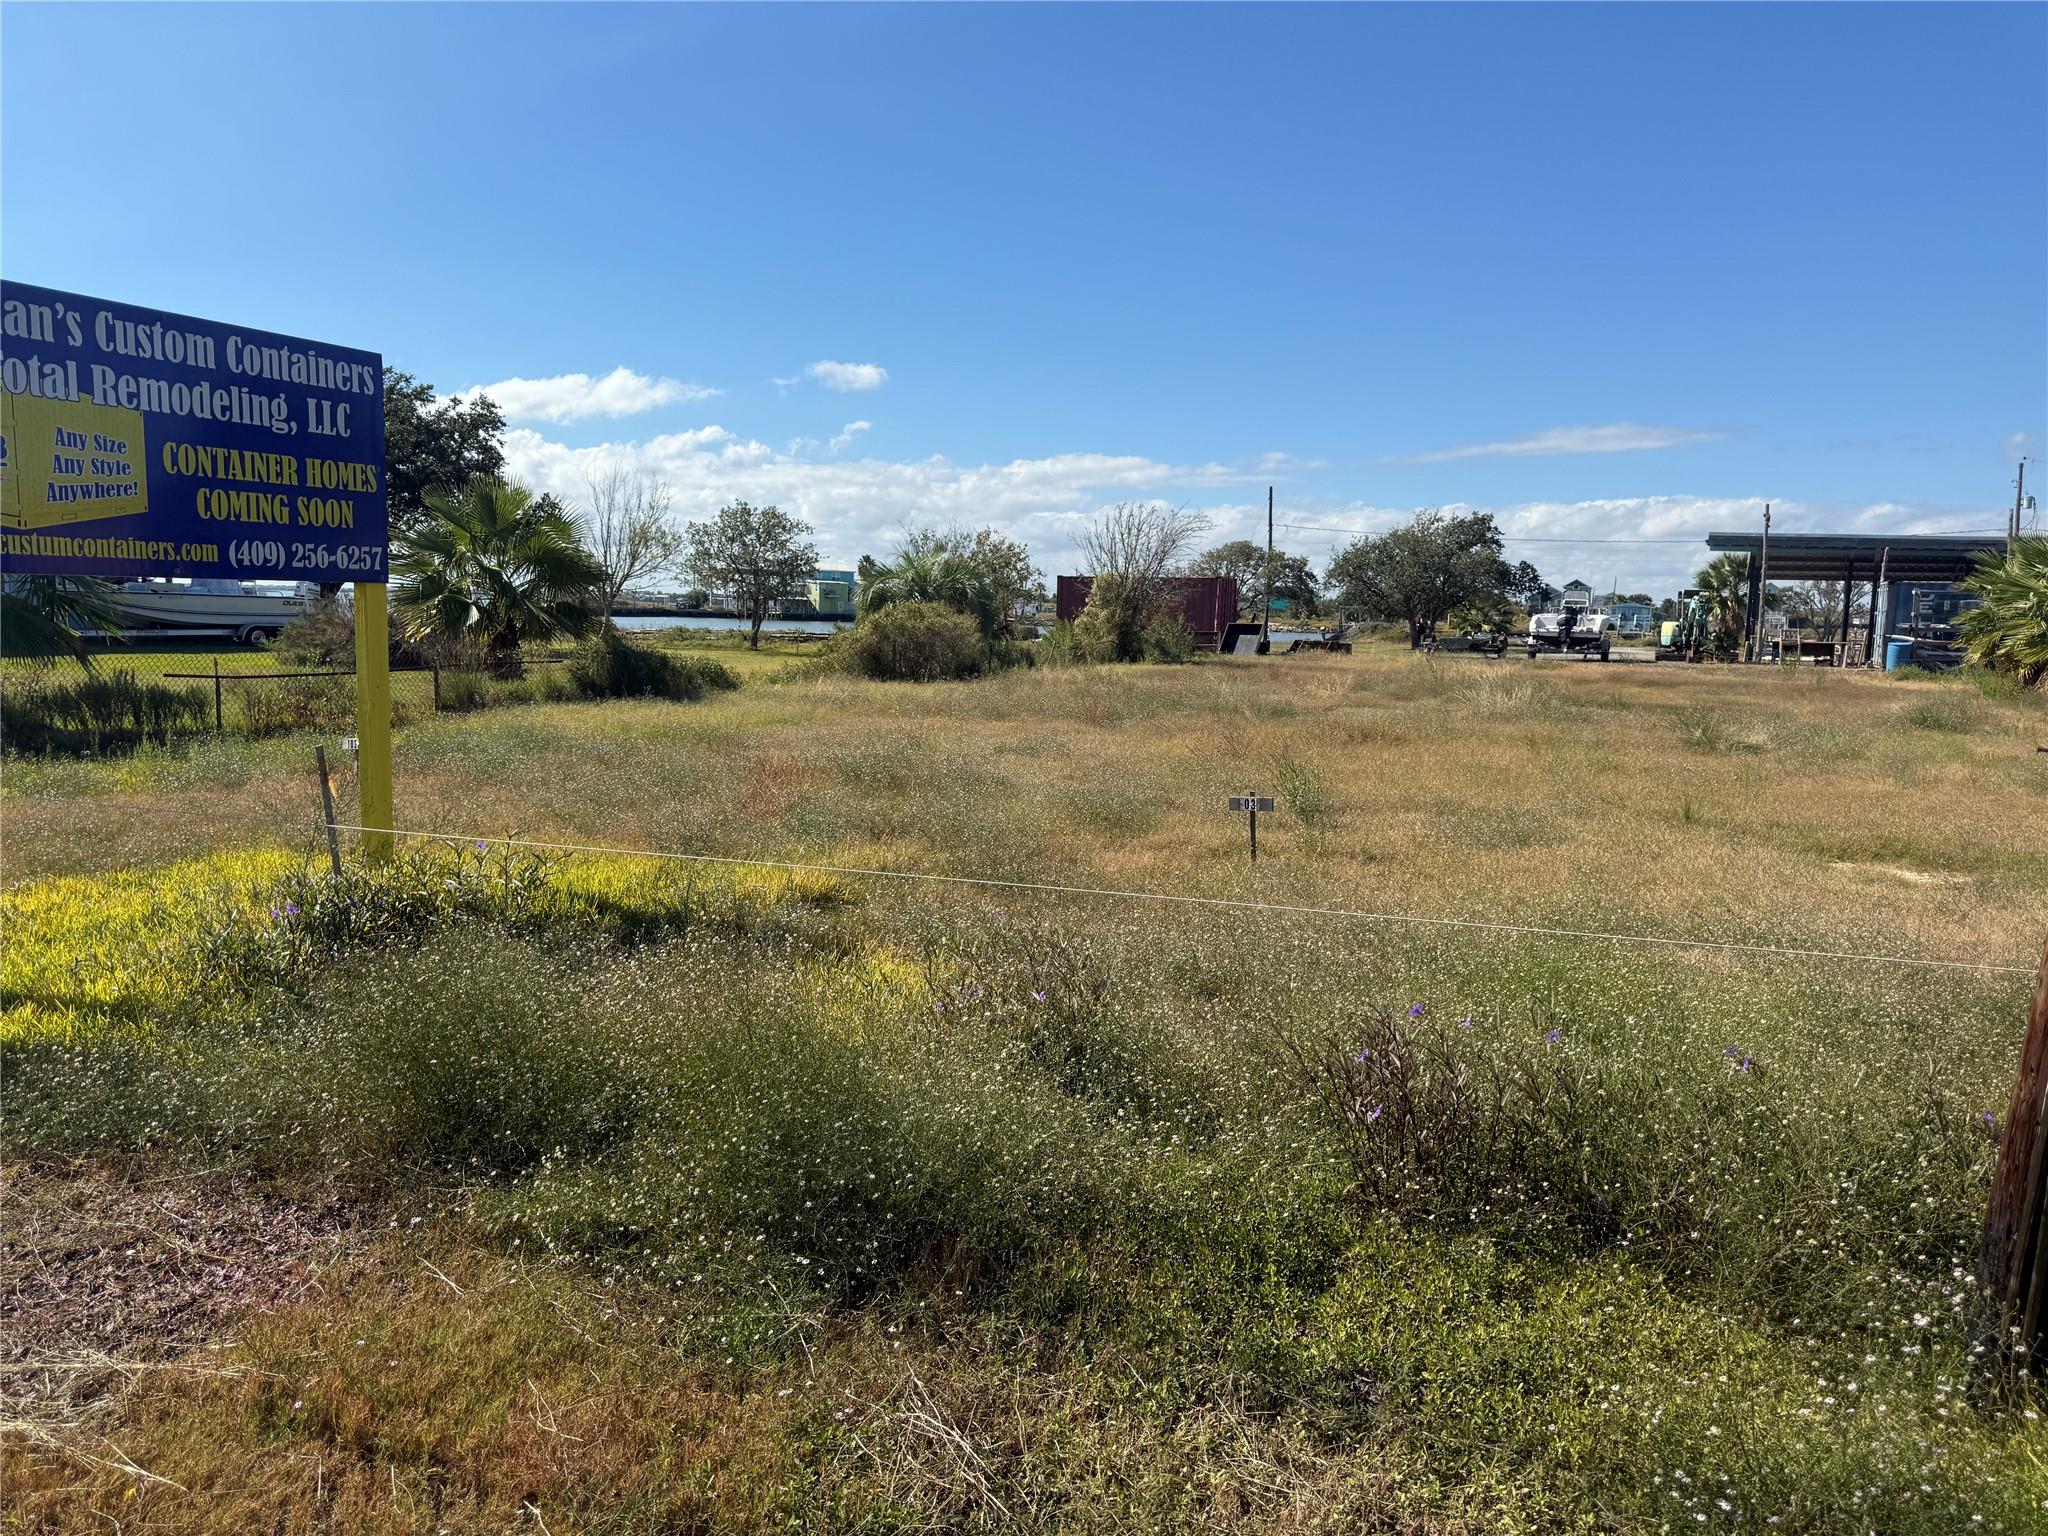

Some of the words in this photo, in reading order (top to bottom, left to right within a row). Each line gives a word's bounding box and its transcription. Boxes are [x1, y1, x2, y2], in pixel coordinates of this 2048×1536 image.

[0, 299, 83, 347] an's
[95, 310, 217, 370] Custom
[226, 334, 375, 396] Containers
[0, 349, 80, 402] otal
[90, 363, 298, 435] Remodeling,
[307, 397, 351, 438] LLC
[55, 426, 88, 451] Any
[93, 433, 127, 455] Size
[52, 454, 85, 477] Any
[91, 457, 132, 477] Style
[162, 441, 299, 486] CONTAINER
[305, 457, 378, 494] HOMES
[46, 481, 139, 503] Anywhere!
[196, 487, 290, 526] COMING
[297, 495, 354, 529] SOON
[228, 539, 286, 569] (409)
[291, 542, 383, 571] 256-6257
